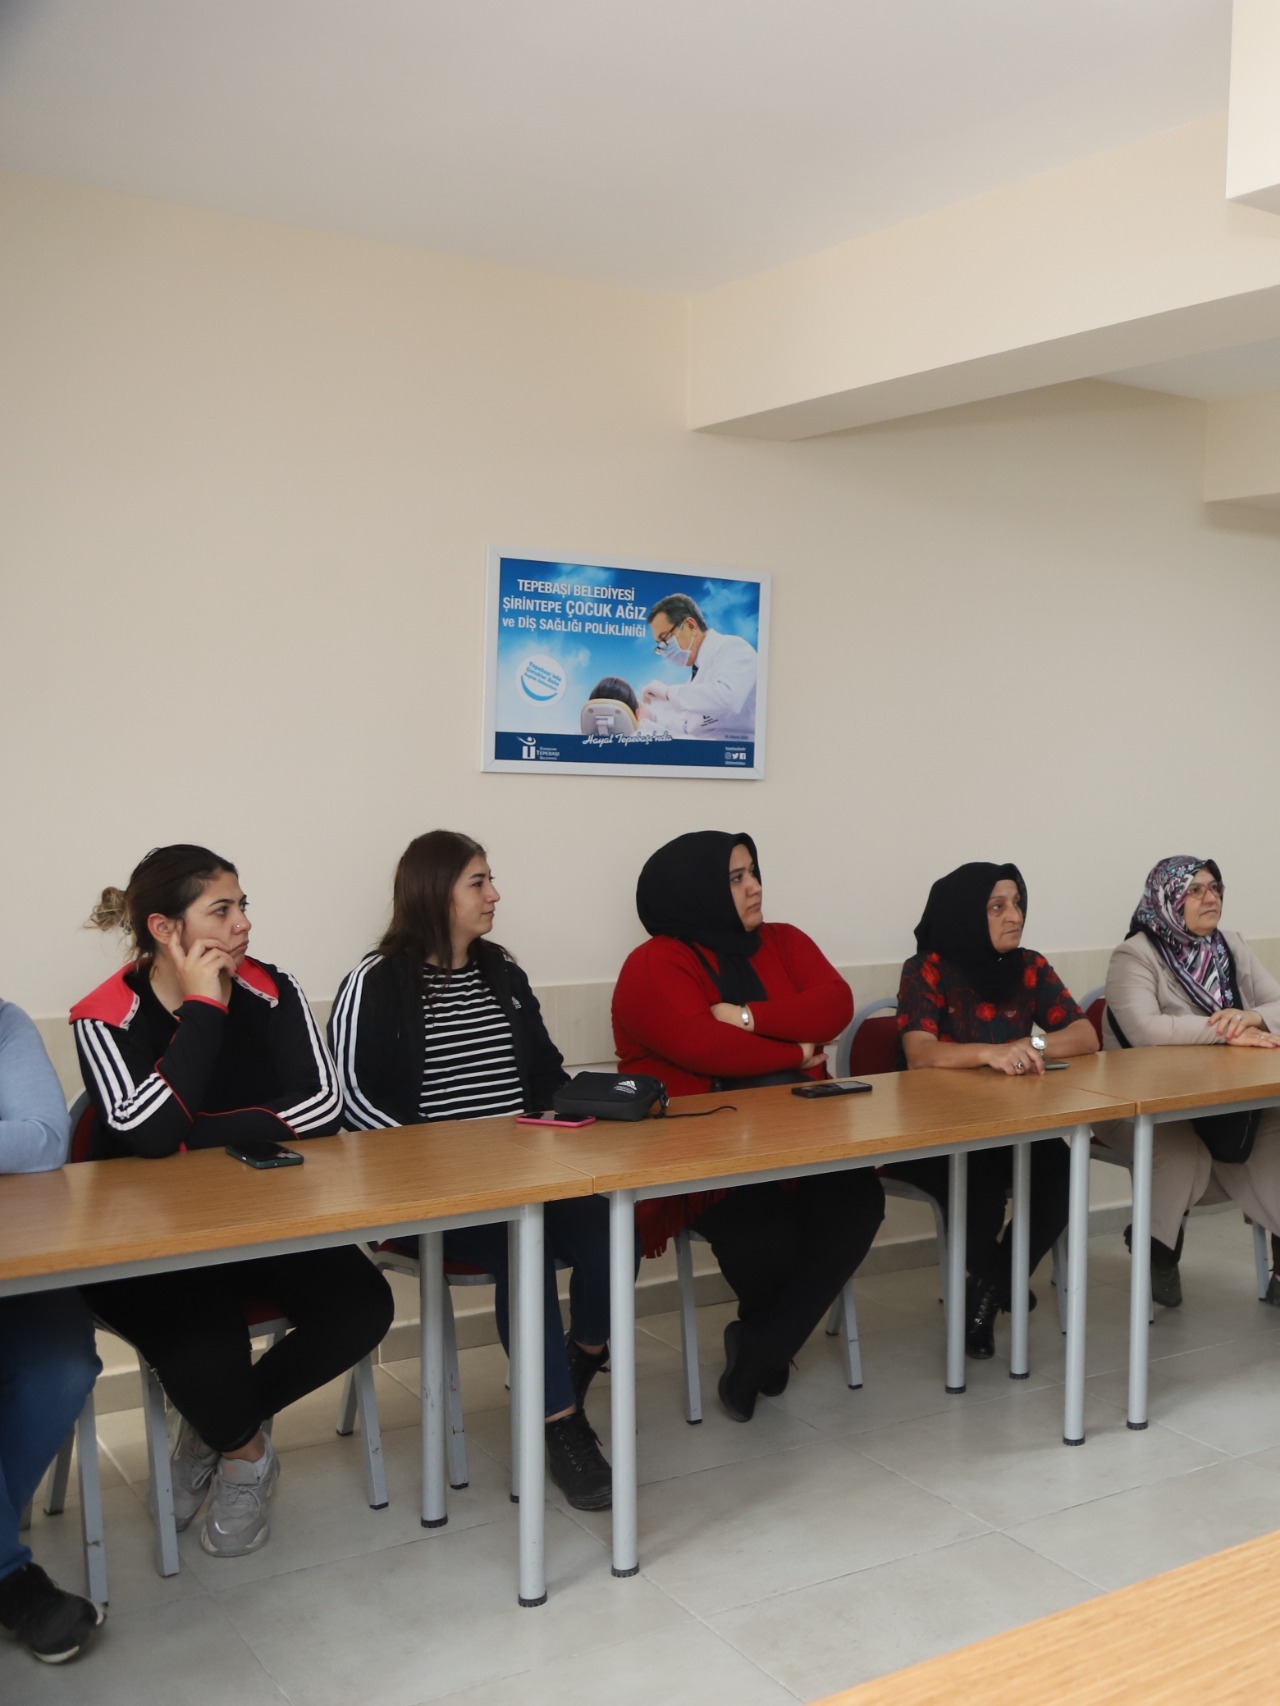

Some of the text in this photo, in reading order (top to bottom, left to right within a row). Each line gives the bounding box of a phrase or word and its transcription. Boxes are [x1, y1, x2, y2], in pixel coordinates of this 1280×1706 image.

[516, 578, 635, 601] TEPEBAŞI BELEDİYESİ
[502, 595, 648, 621] ŞİRİNTEPE ÇOCUK AĞIZ
[501, 614, 646, 638] ve DİŞ SAĞLIĞI POLİKLİNİĞİ
[582, 733, 614, 748] Hayal
